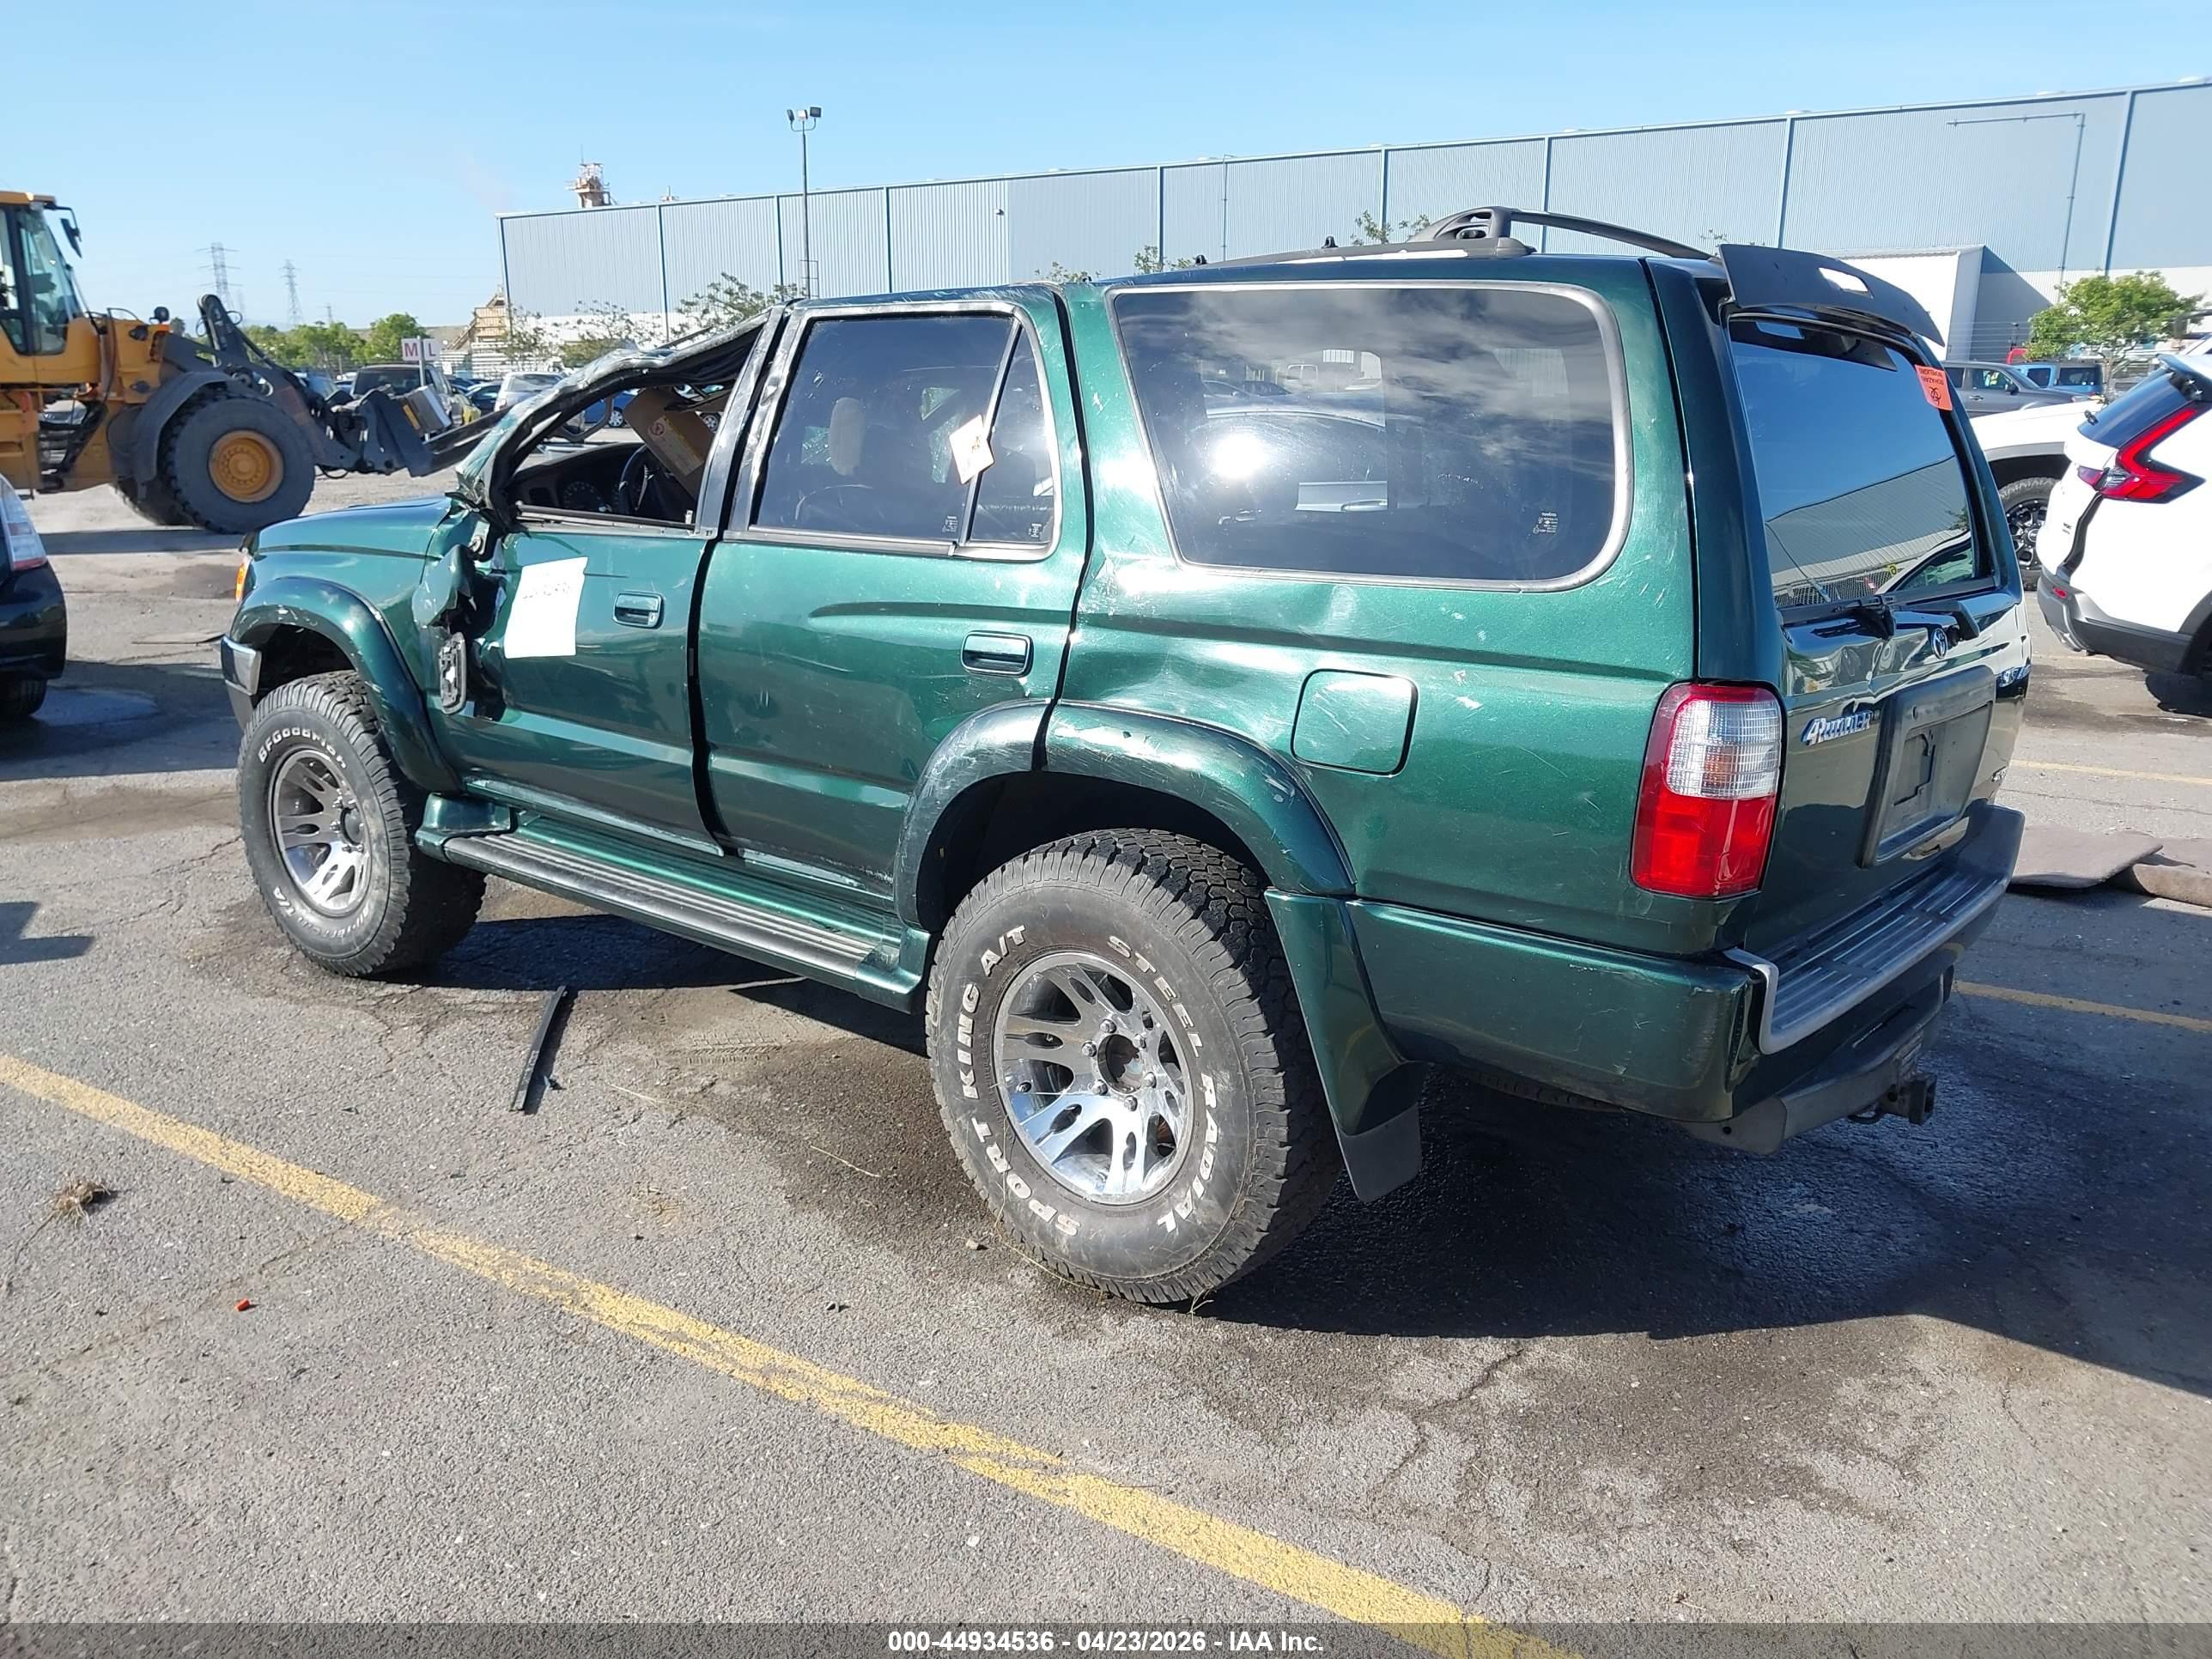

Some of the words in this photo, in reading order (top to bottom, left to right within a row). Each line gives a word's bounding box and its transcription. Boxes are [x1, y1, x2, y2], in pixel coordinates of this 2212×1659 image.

[404, 343, 418, 357] M
[428, 343, 437, 356] L
[981, 925, 1025, 976] A/T
[957, 983, 980, 1100] KING
[1108, 936, 1203, 1058] STEEL
[1157, 1073, 1218, 1233] RADIAL
[971, 1117, 1080, 1236] SPORT
